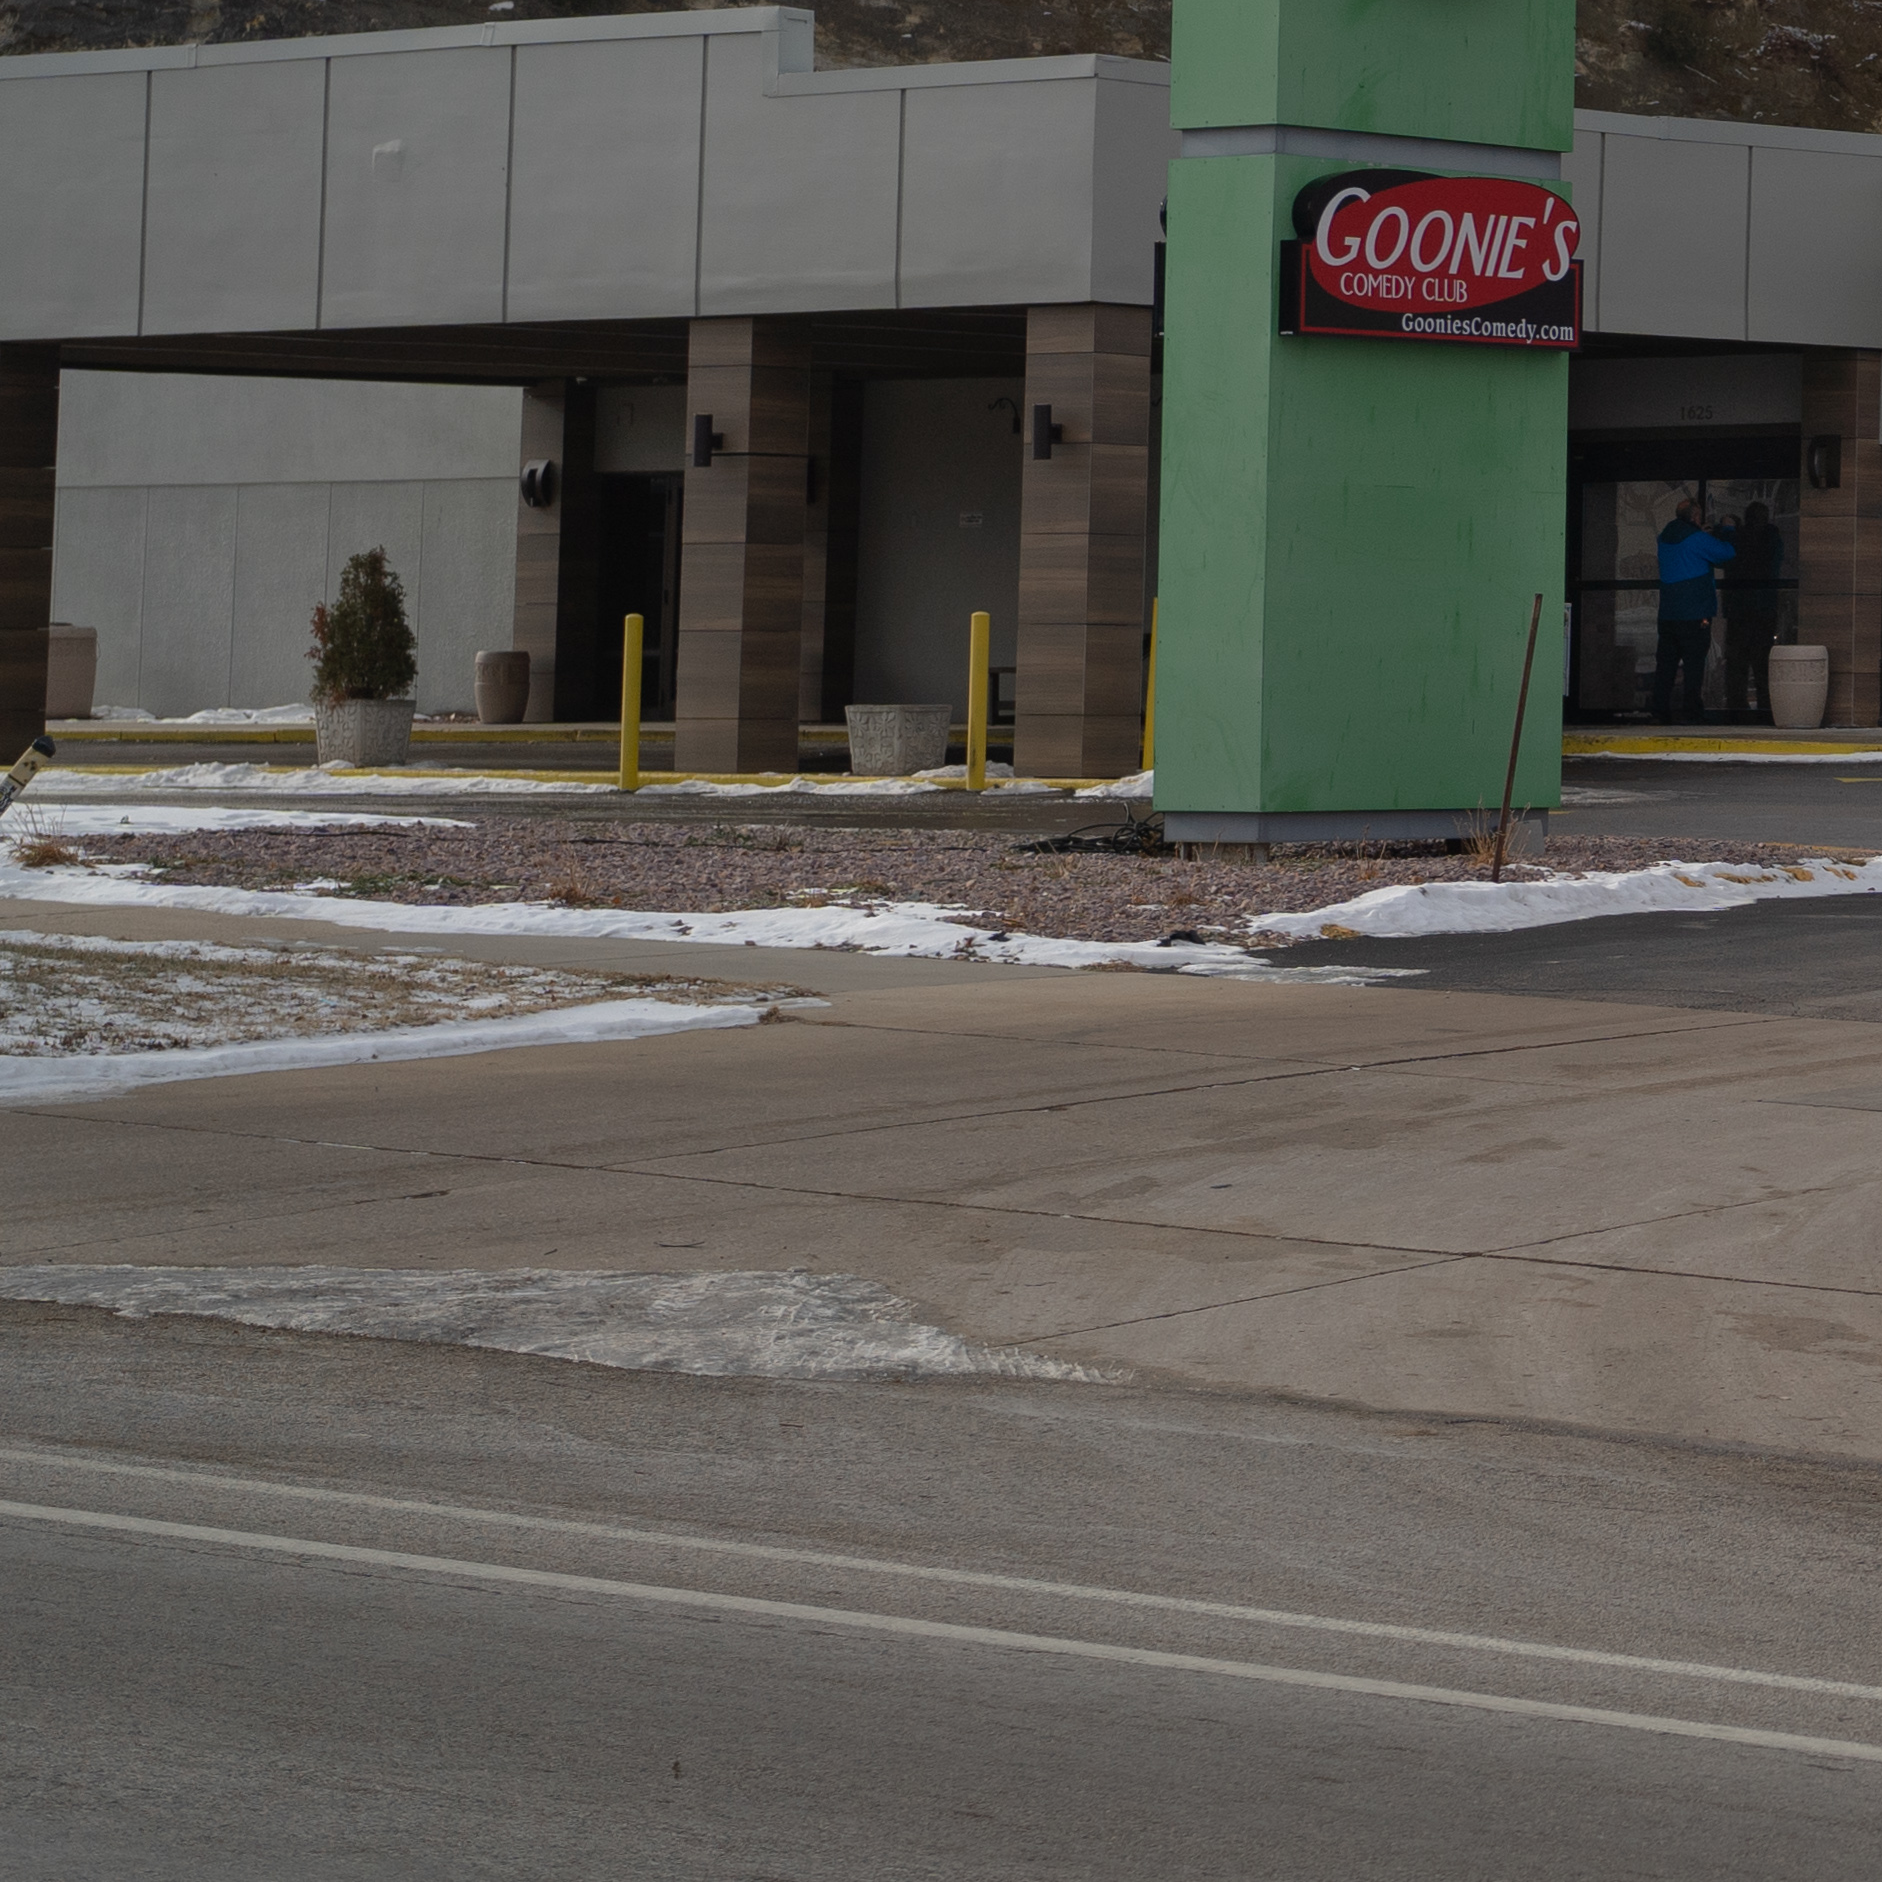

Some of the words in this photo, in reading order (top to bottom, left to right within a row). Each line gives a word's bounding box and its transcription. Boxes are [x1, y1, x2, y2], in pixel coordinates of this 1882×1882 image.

[1316, 187, 1578, 282] GOONIE'S
[1340, 272, 1416, 300] COMEDY
[1422, 277, 1468, 303] CLUB
[1402, 313, 1574, 344] GooniesComedy.com
[1681, 405, 1713, 420] 1625
